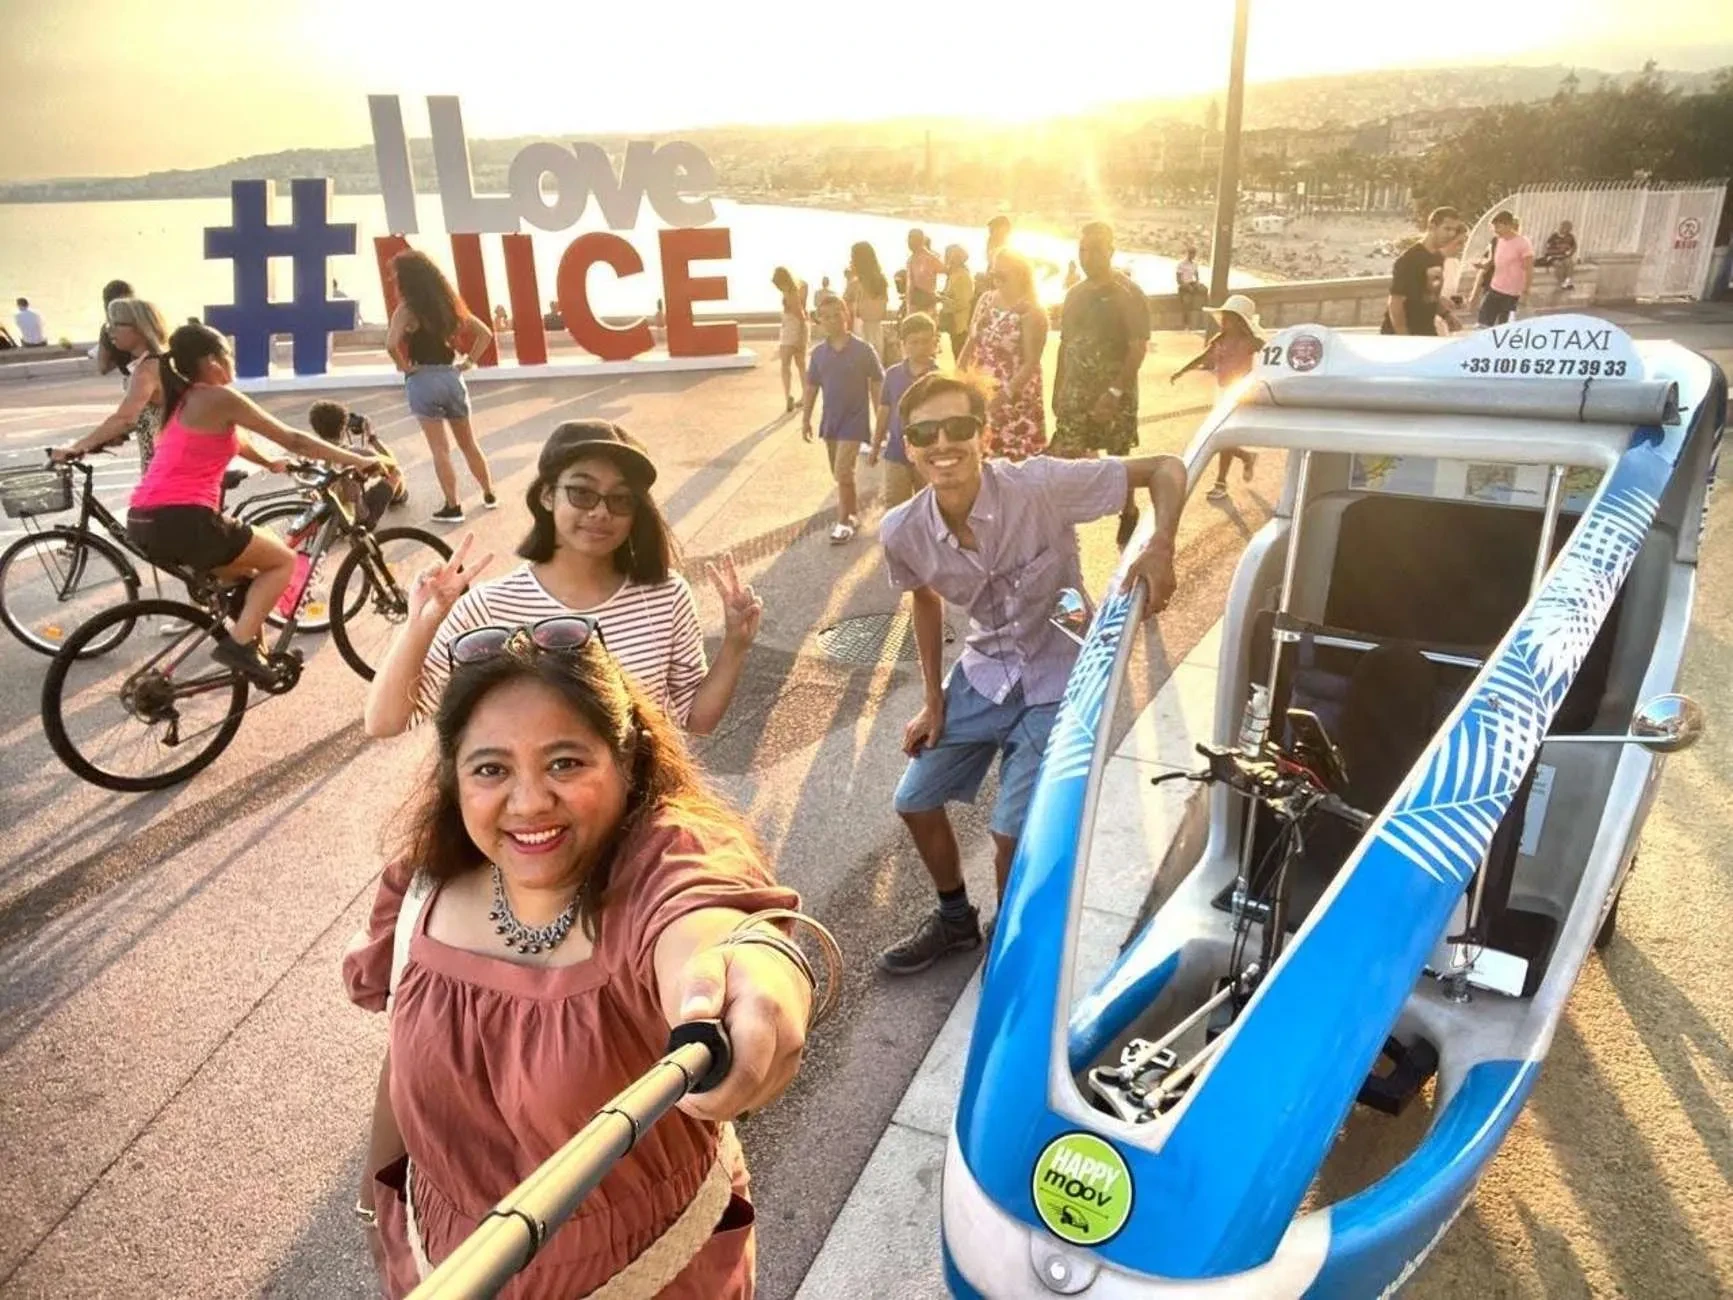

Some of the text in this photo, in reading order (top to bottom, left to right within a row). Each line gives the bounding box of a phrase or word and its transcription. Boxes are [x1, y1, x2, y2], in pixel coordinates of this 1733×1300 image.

[367, 94, 717, 234] I Love
[1492, 328, 1612, 350] VéloTAXI
[1263, 346, 1282, 366] 12
[1460, 358, 1490, 373] +33
[1520, 359, 1531, 374] 6
[1534, 359, 1555, 374] 52
[1558, 360, 1576, 375] 77
[1578, 360, 1600, 376] 39
[1604, 360, 1627, 376] 33
[1050, 1144, 1121, 1193] HAPPY
